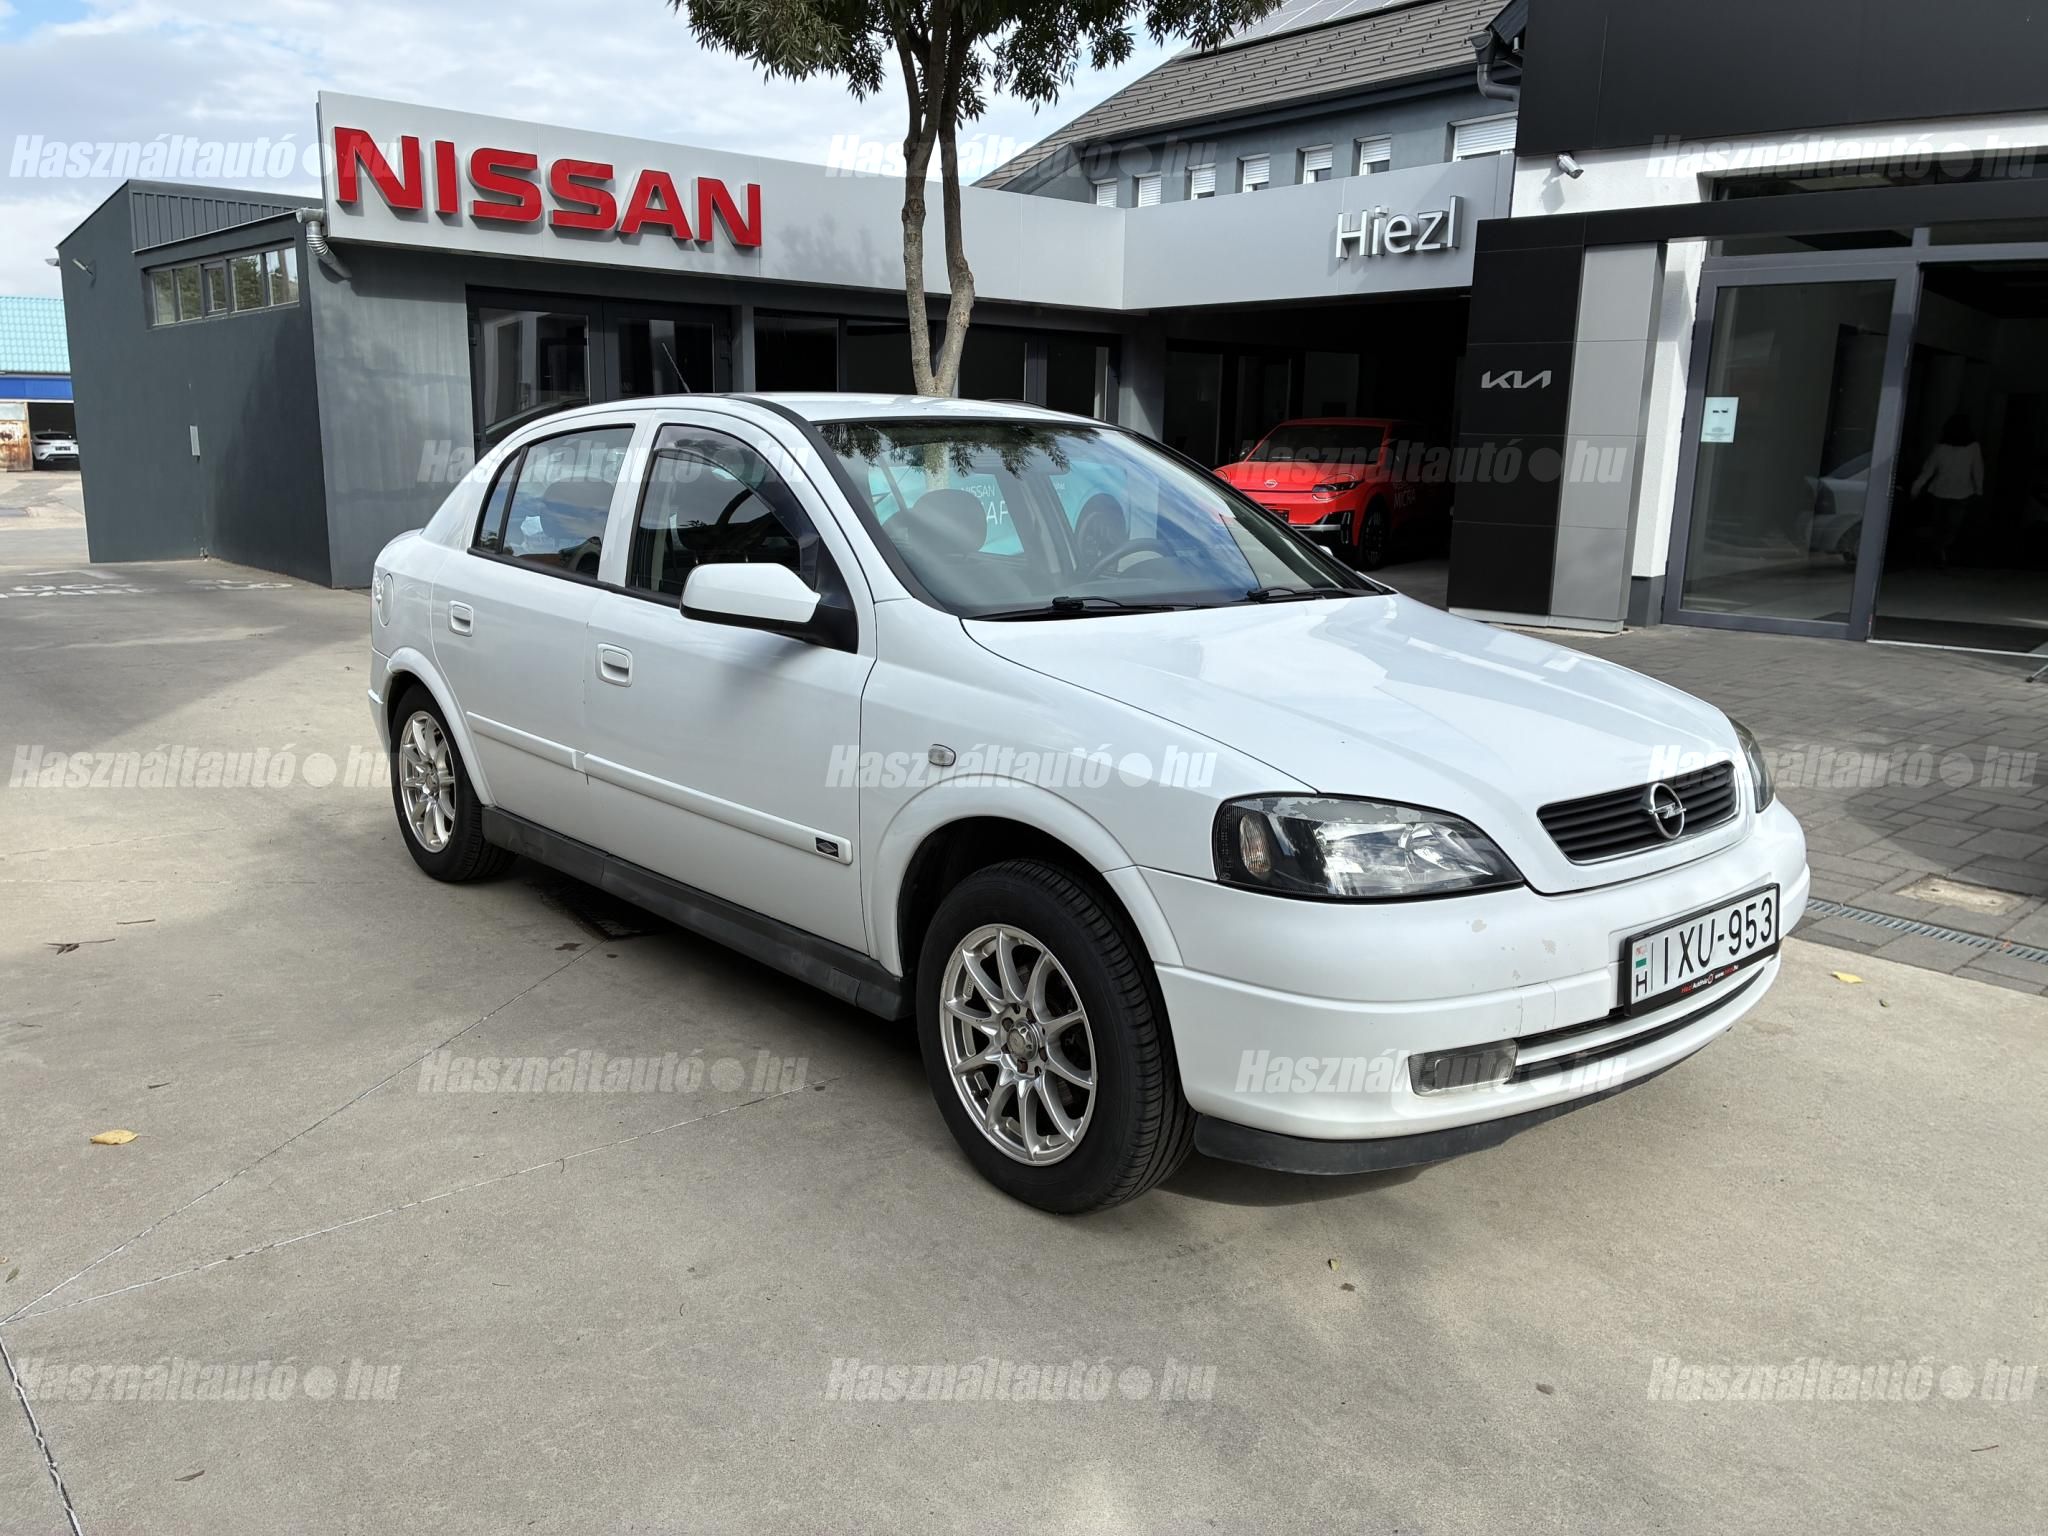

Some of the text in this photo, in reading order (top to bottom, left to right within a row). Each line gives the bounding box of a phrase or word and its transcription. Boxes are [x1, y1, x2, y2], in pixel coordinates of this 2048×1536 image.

[334, 126, 762, 248] NISSAN
[1335, 195, 1464, 260] Hiezl
[1481, 370, 1552, 388] KIA
[961, 484, 995, 498] SSAN
[1664, 896, 1773, 986] IXU-953
[1635, 970, 1648, 997] H
